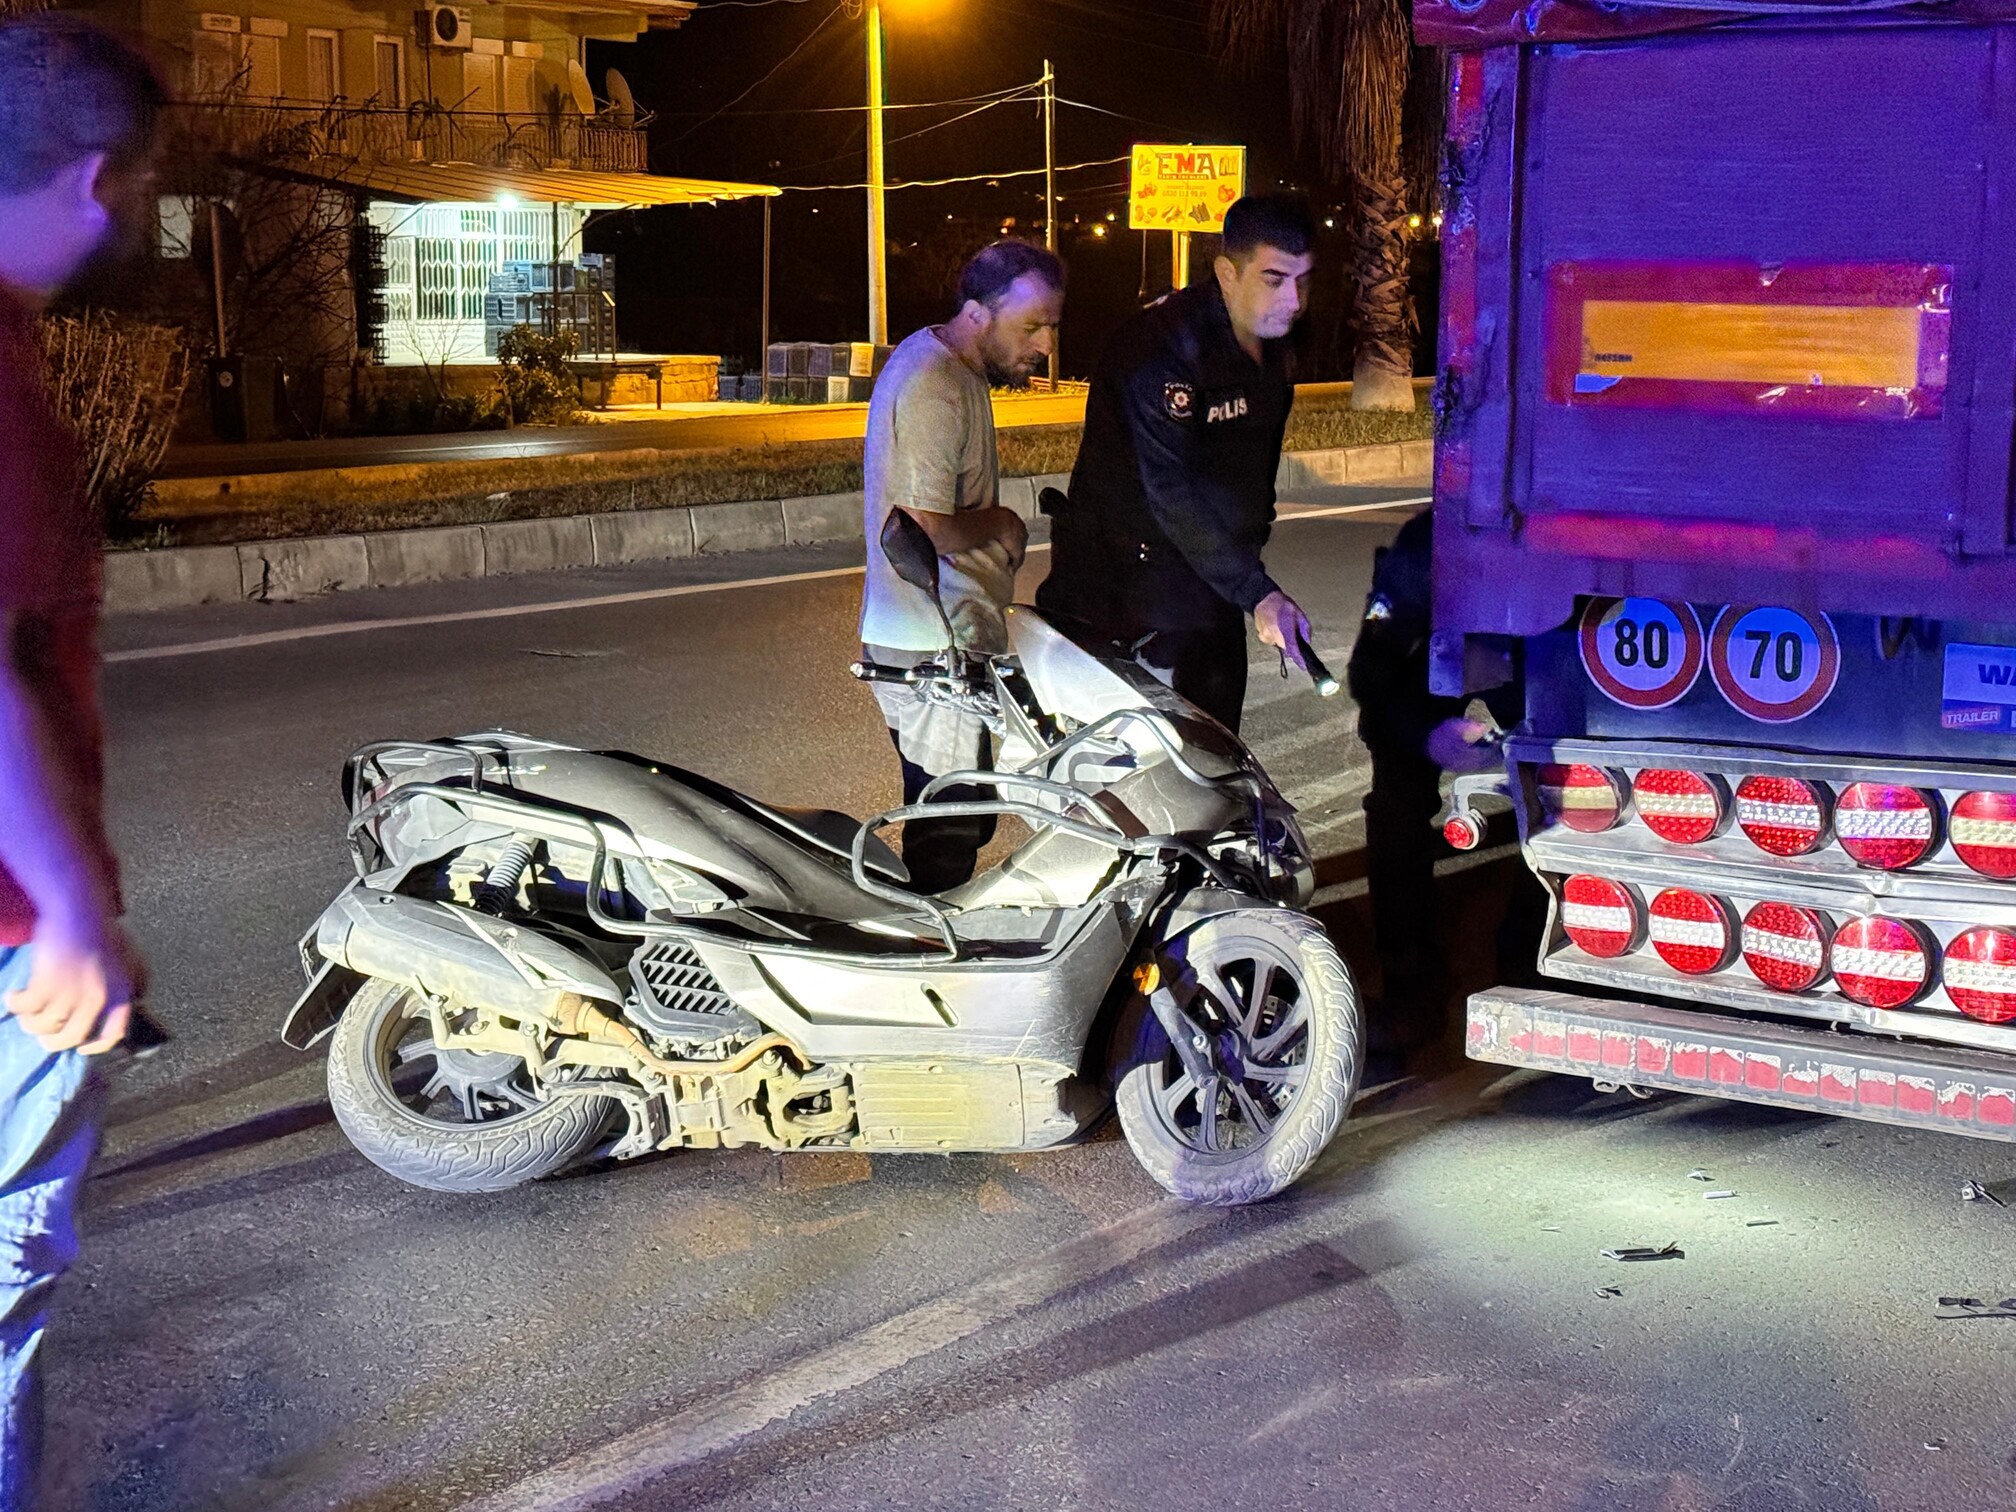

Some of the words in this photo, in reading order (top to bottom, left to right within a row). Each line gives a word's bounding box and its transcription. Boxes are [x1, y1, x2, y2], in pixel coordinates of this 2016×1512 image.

[1155, 152, 1217, 180] EMA
[1614, 617, 1669, 669] 80
[1744, 629, 1803, 683] 70
[1977, 663, 2016, 686] W
[1946, 710, 1999, 725] TRAILER
[391, 1116, 470, 1139] MICHELIN
